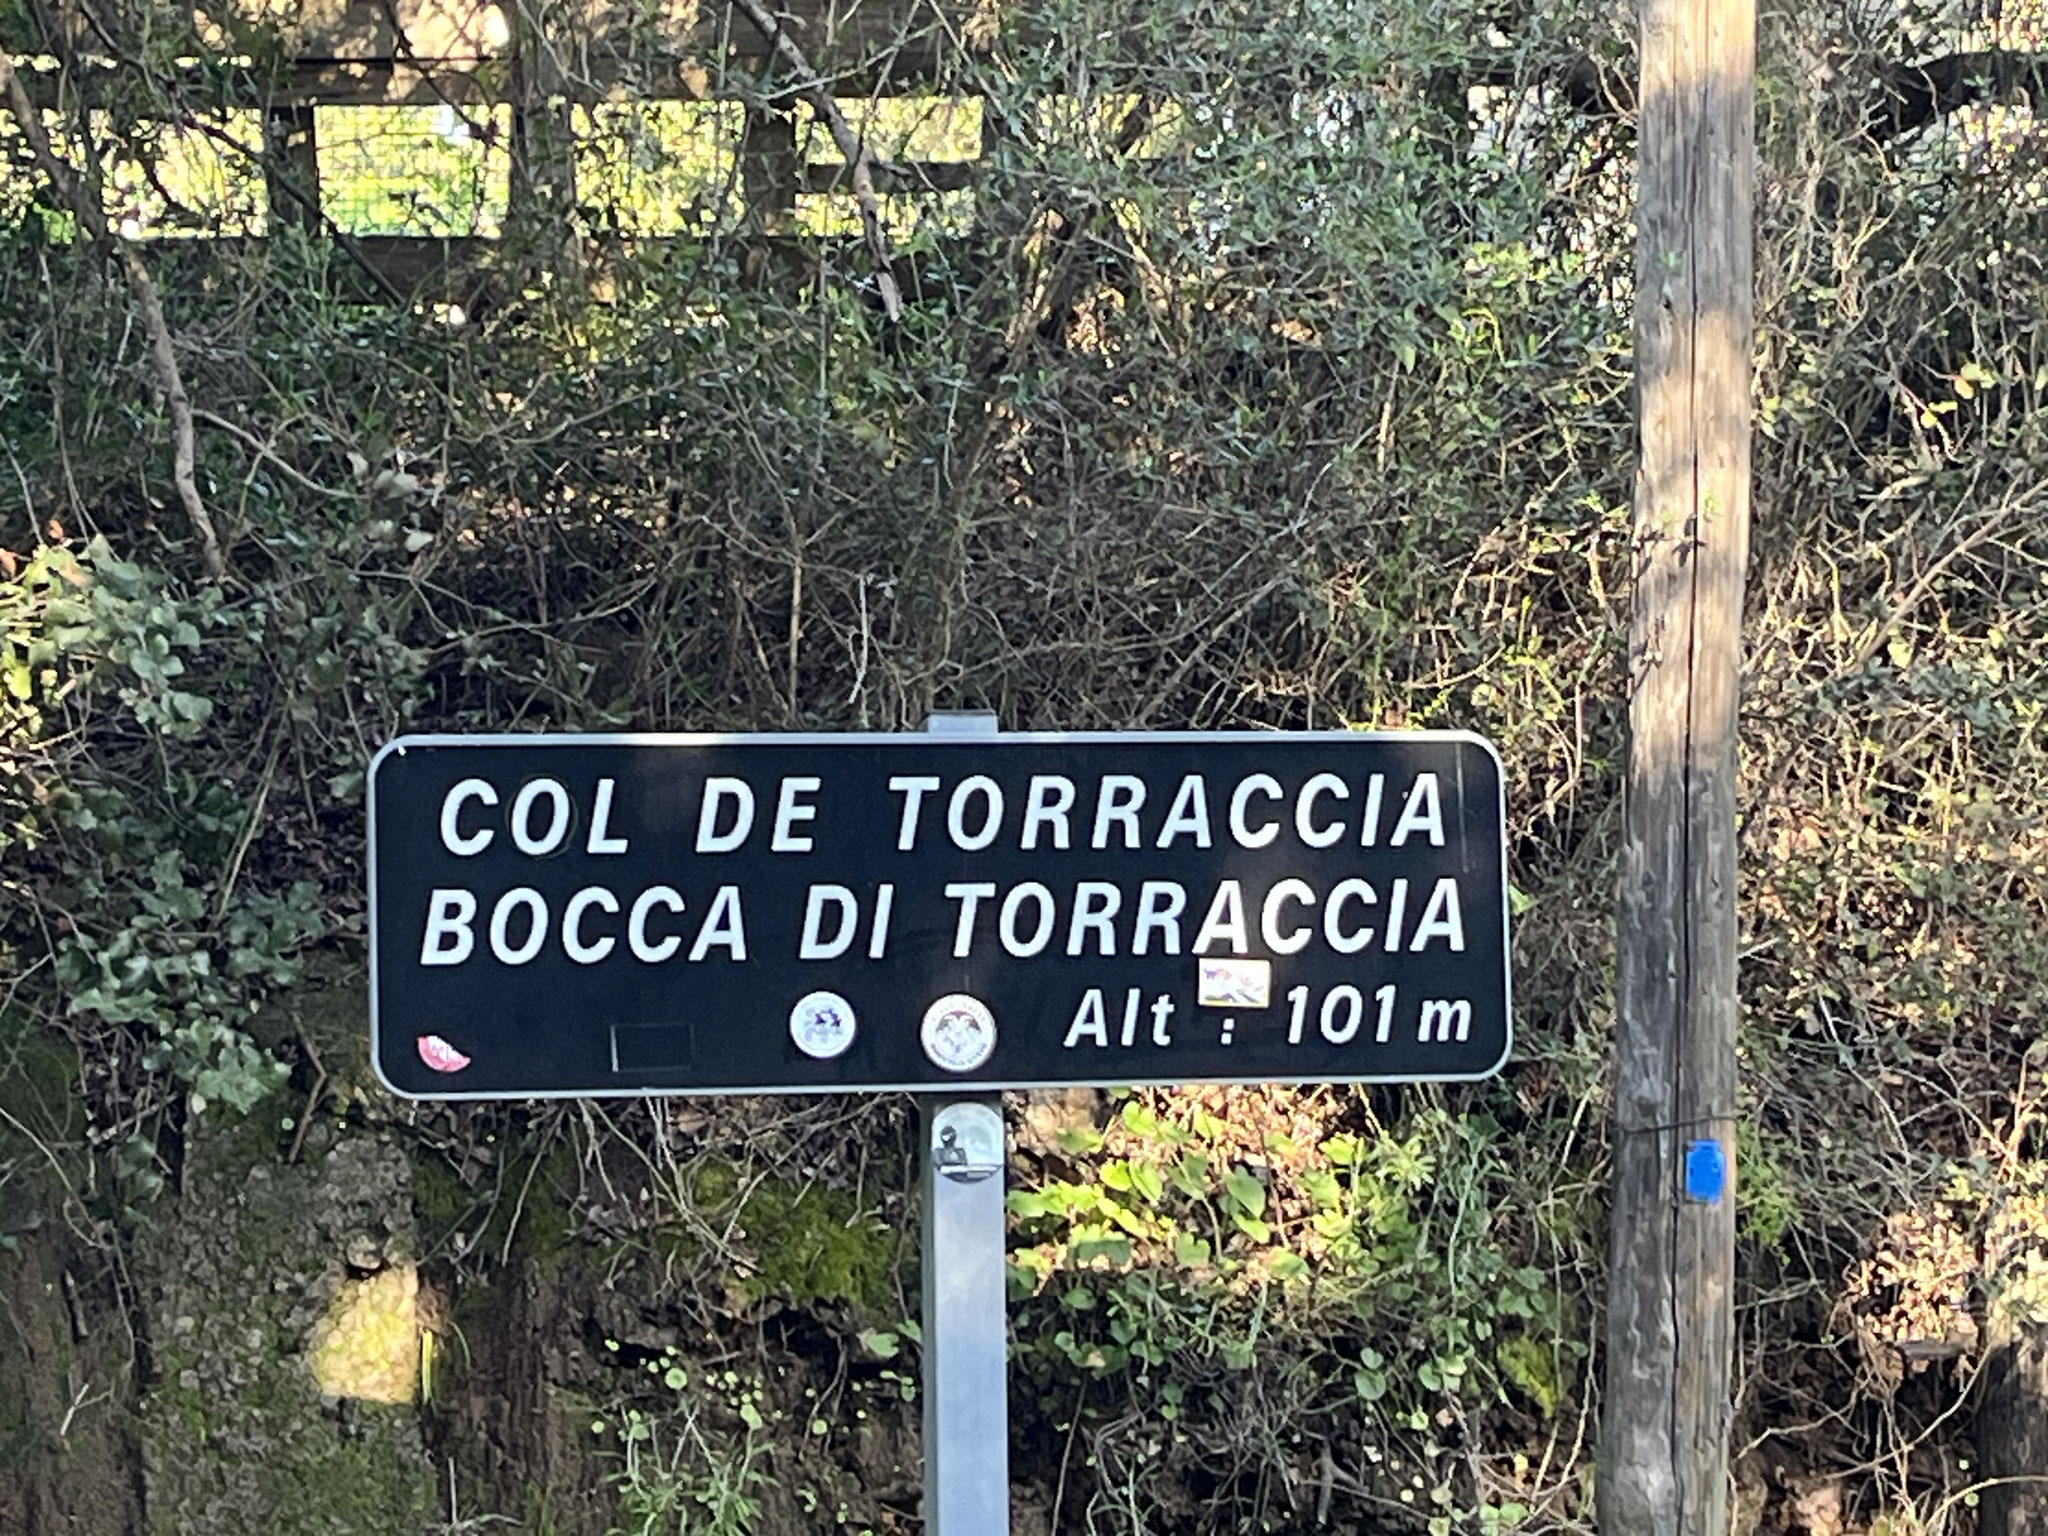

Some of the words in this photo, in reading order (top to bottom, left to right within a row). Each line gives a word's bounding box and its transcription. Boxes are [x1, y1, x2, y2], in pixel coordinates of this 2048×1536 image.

[440, 778, 629, 856] COL
[695, 777, 822, 853] DE
[888, 772, 1445, 851] TORRACCIA
[420, 886, 747, 965] BOCCA
[799, 883, 894, 959] DI
[944, 877, 1465, 958] TORRACCIA
[1063, 987, 1175, 1048] Alt
[1287, 984, 1396, 1044] 101
[1417, 999, 1472, 1042] m
